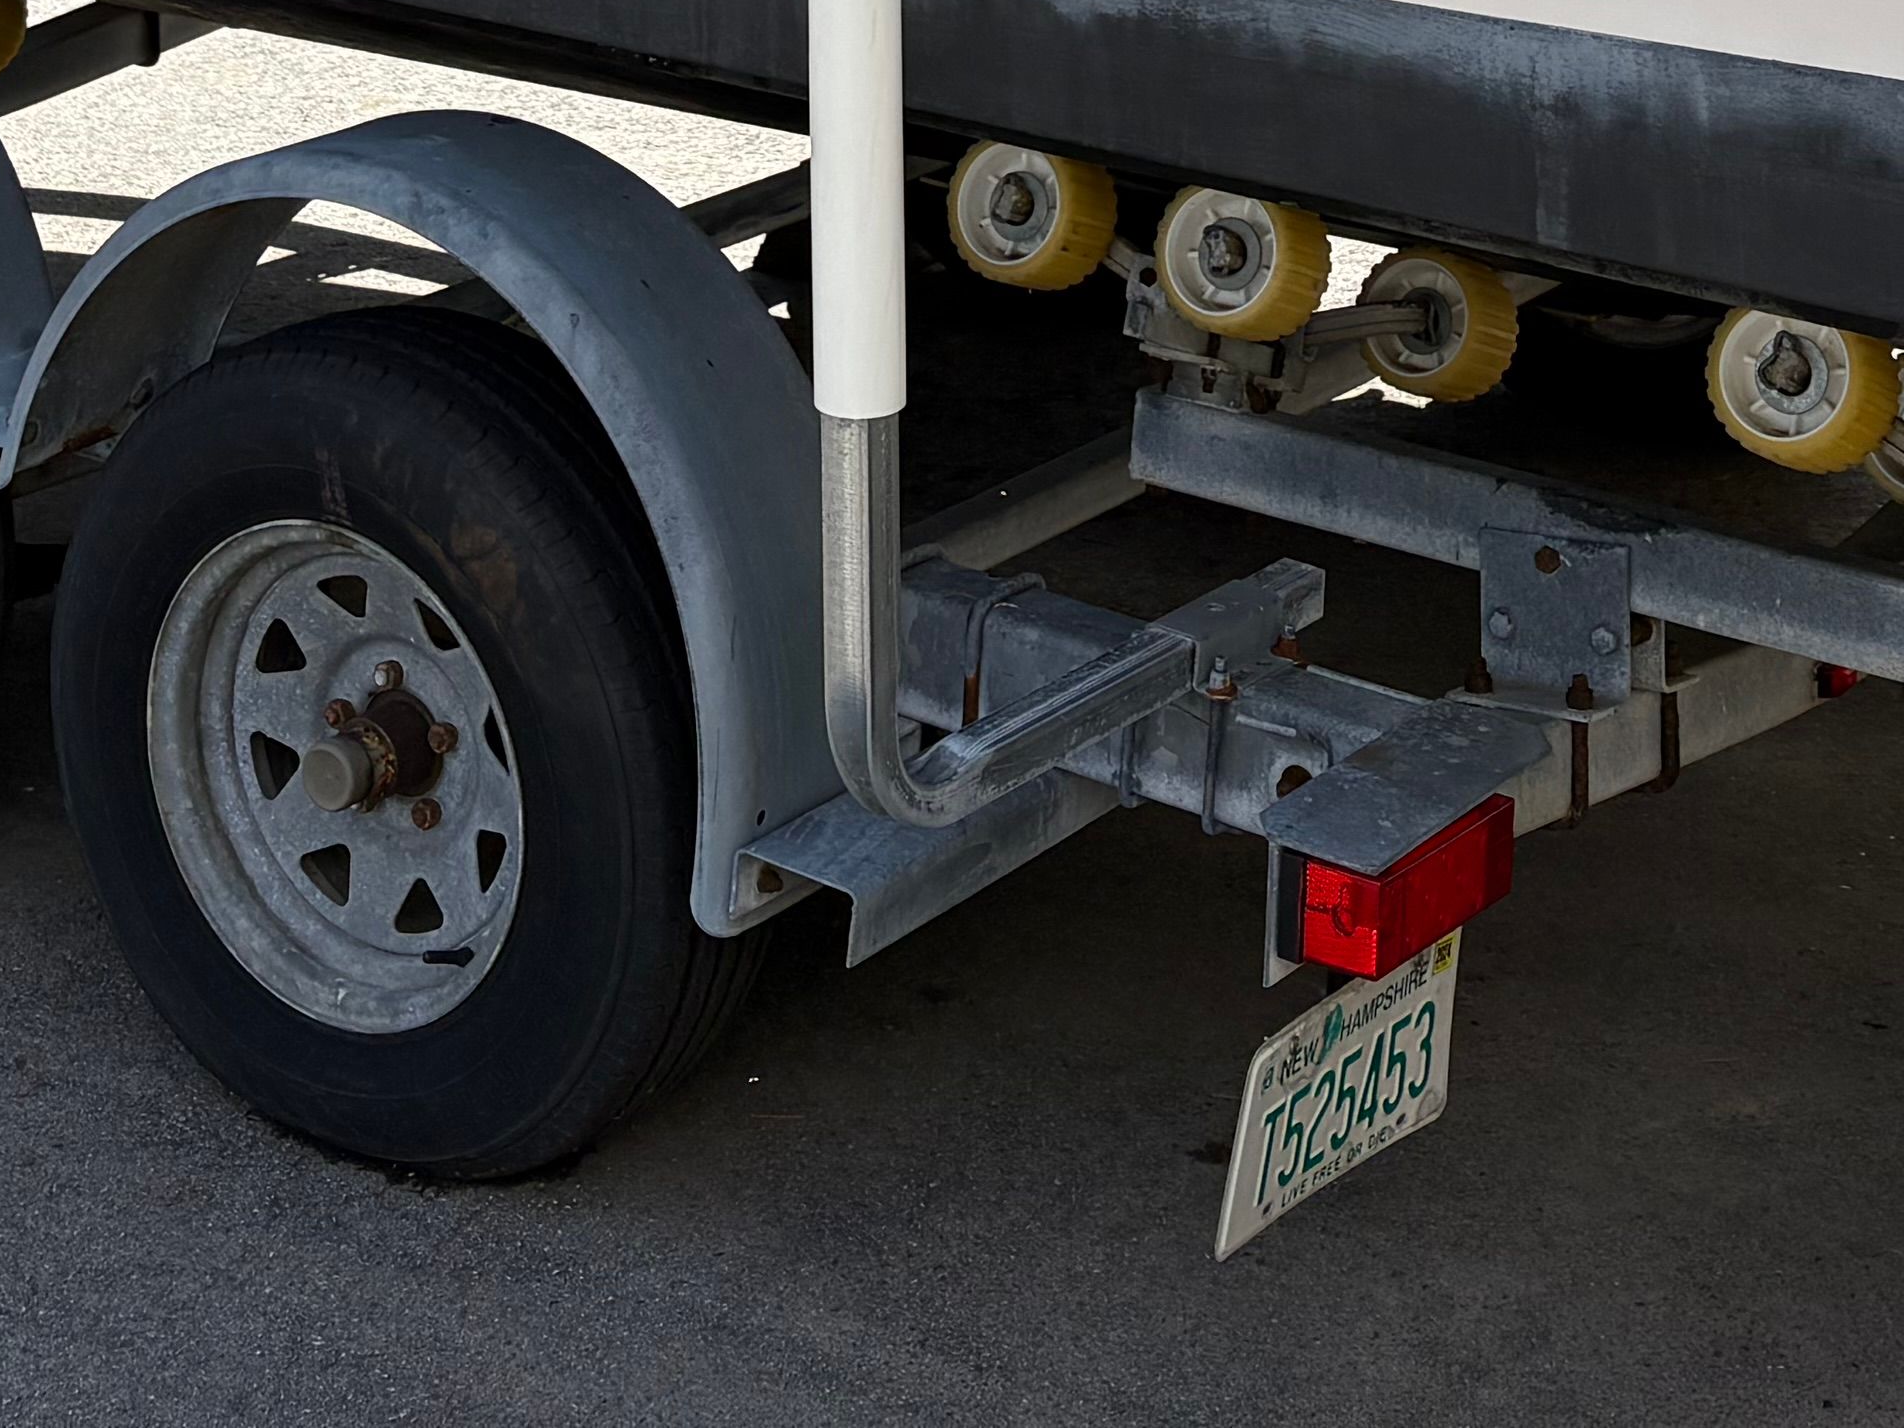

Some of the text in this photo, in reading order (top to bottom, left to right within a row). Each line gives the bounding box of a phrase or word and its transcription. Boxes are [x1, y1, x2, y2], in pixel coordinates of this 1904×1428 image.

[1279, 1036, 1321, 1087] NEW
[1339, 960, 1430, 1042] HAMPSHIRE
[1256, 1000, 1436, 1207] T525453
[1281, 1125, 1388, 1209] LIVE FREE OR DIE
